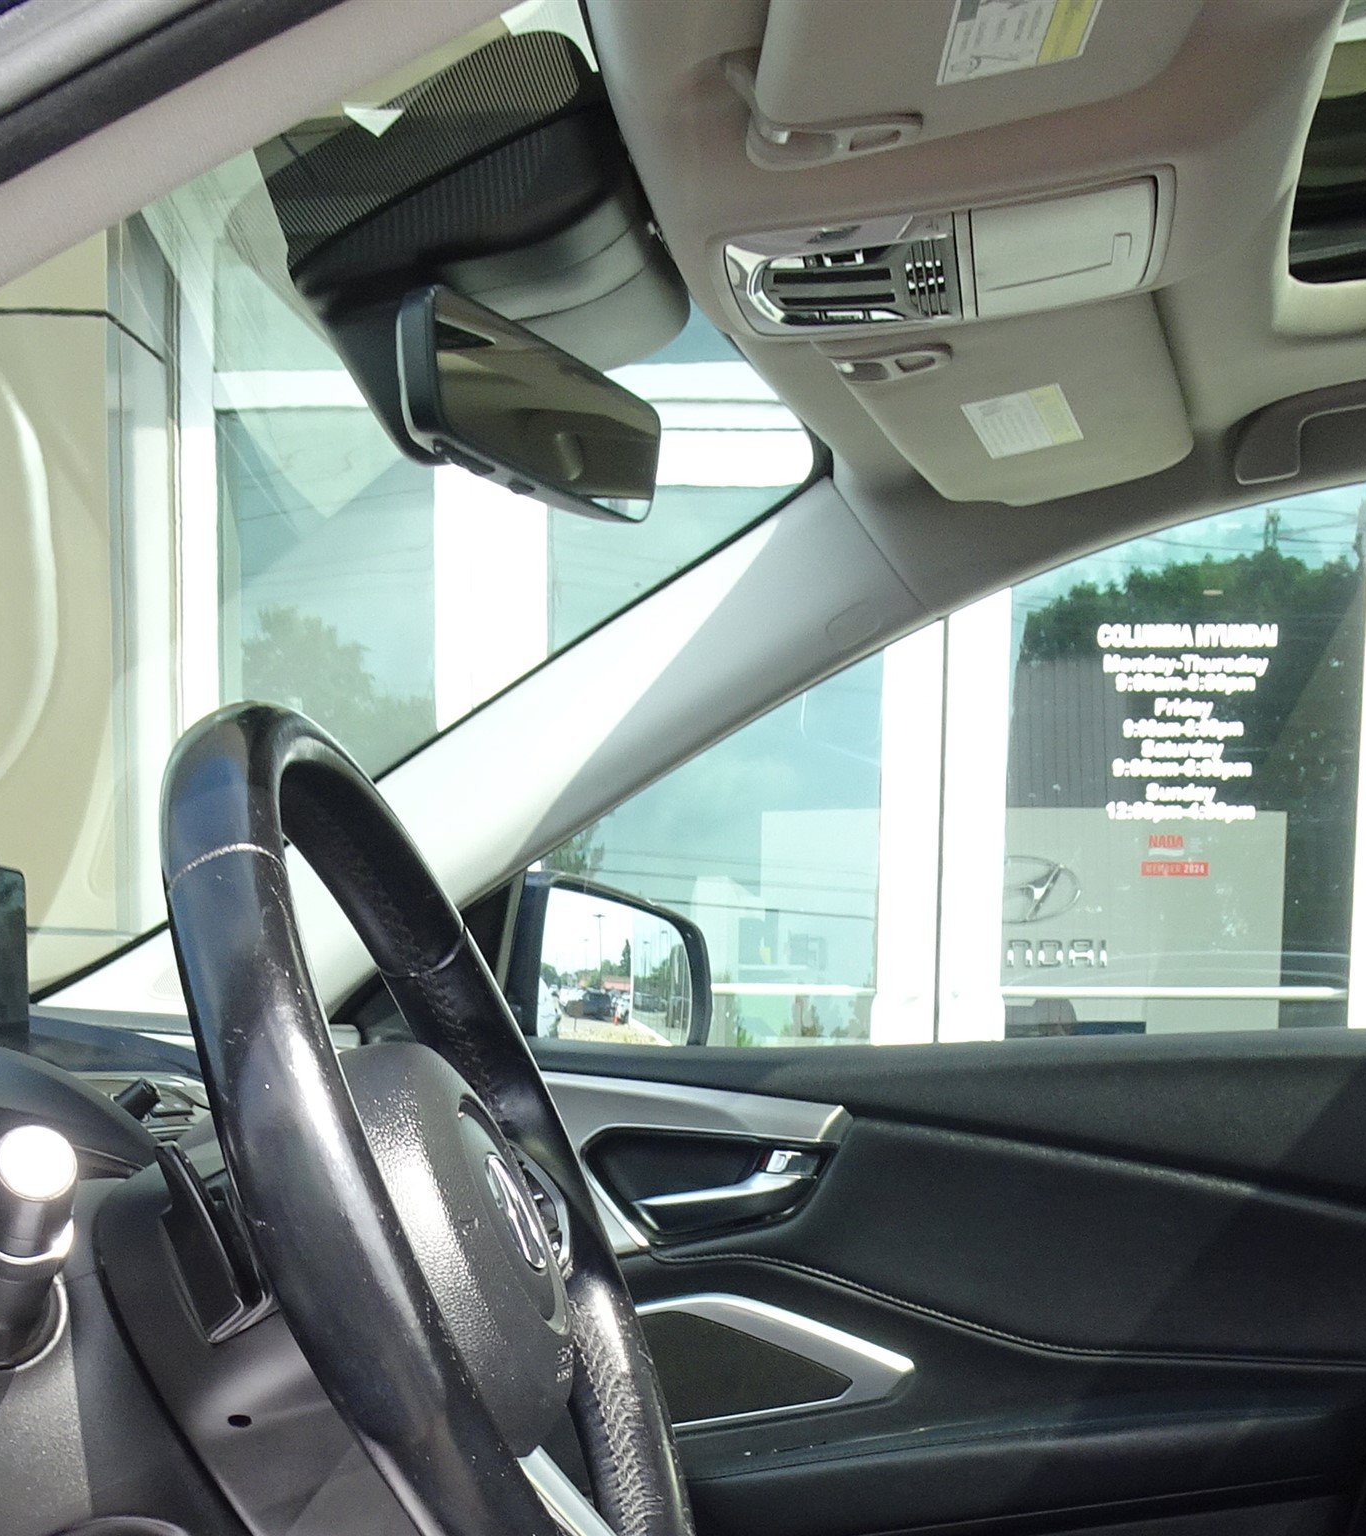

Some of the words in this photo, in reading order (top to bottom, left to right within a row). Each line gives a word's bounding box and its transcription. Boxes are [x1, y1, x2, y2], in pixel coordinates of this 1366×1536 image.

[1154, 698, 1214, 719] Friday
[1141, 739, 1224, 761] Saturday
[1146, 782, 1216, 805] Sunday
